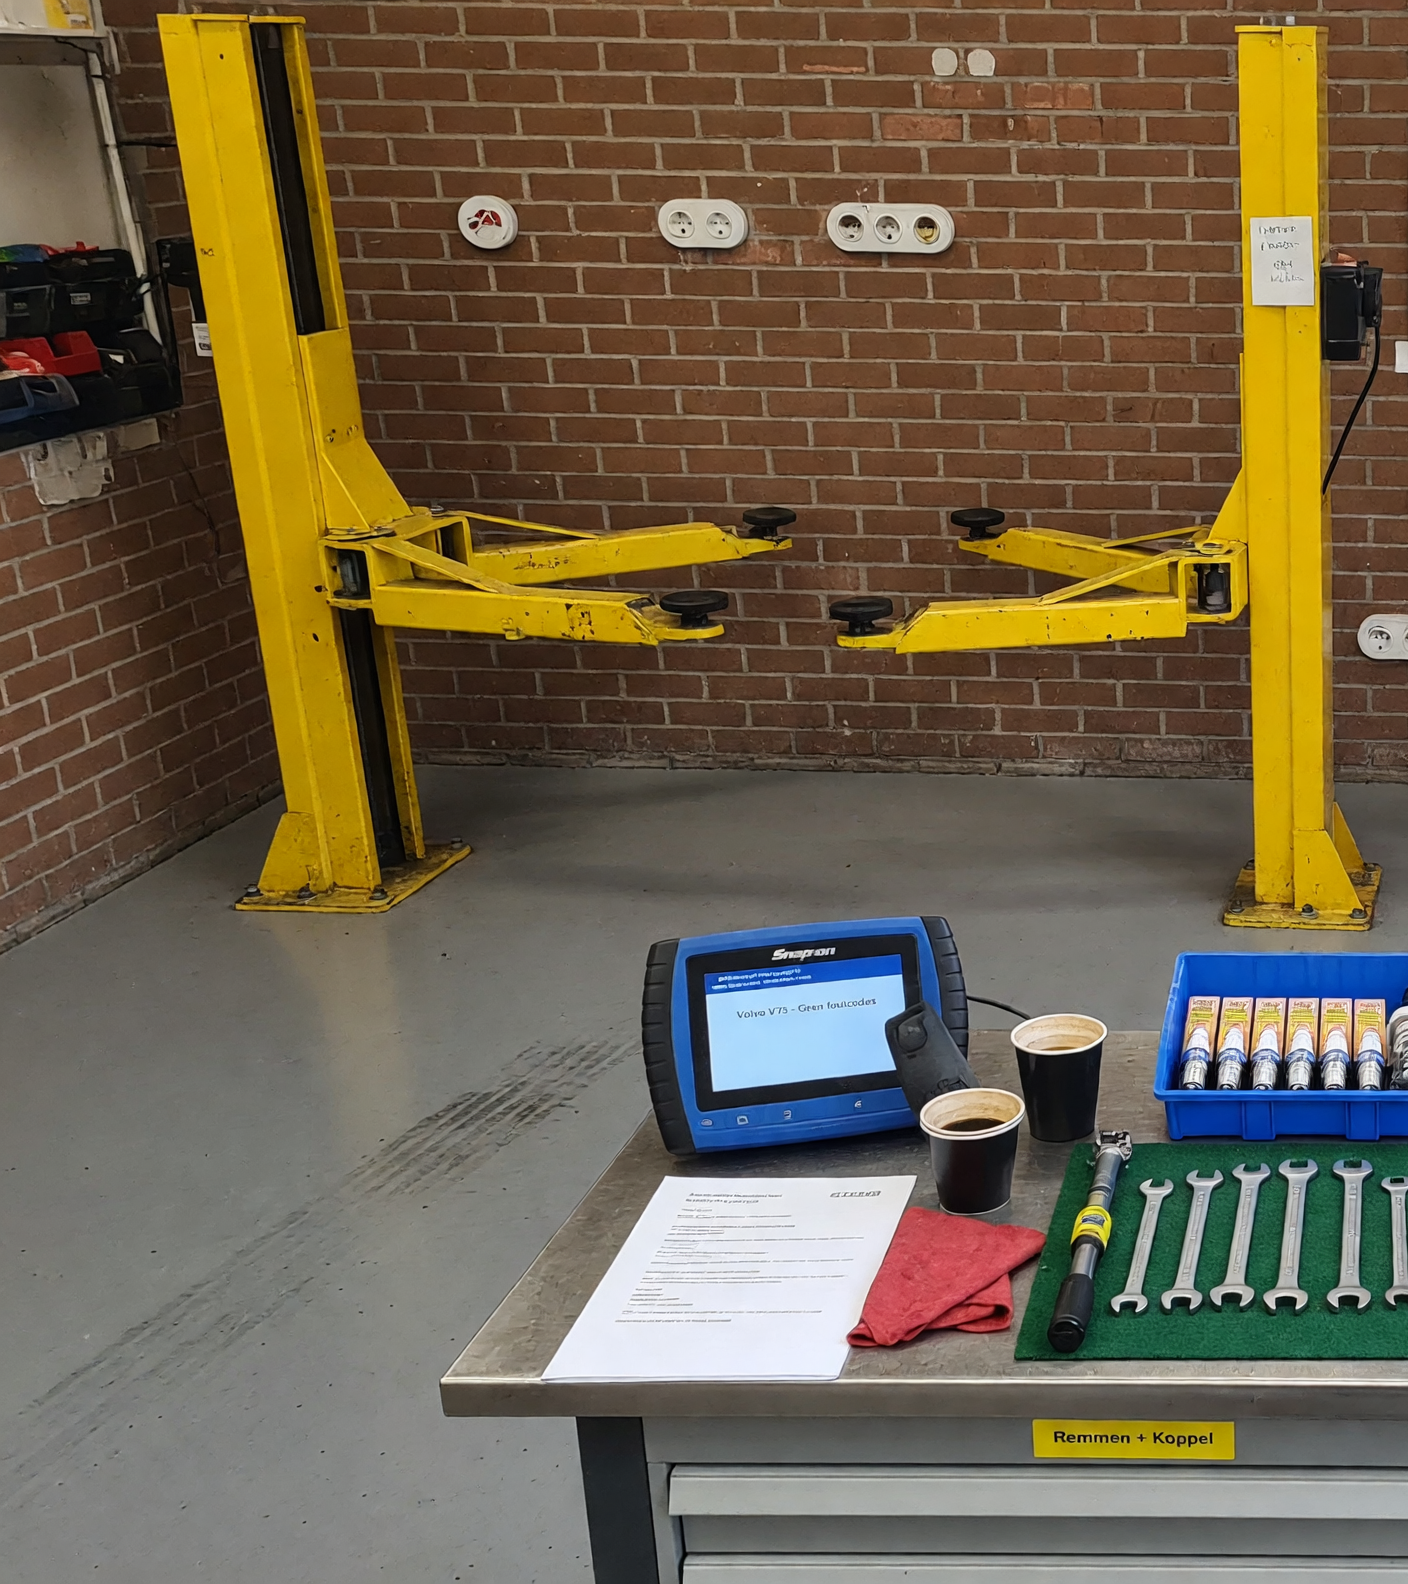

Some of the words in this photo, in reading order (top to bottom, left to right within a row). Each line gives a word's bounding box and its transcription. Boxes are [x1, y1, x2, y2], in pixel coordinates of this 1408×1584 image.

[736, 1010, 766, 1019] Volvo
[768, 1006, 788, 1015] V75
[1053, 1431, 1131, 1444] Remmen
[1136, 1433, 1147, 1443] +
[1152, 1431, 1214, 1448] Koppel
